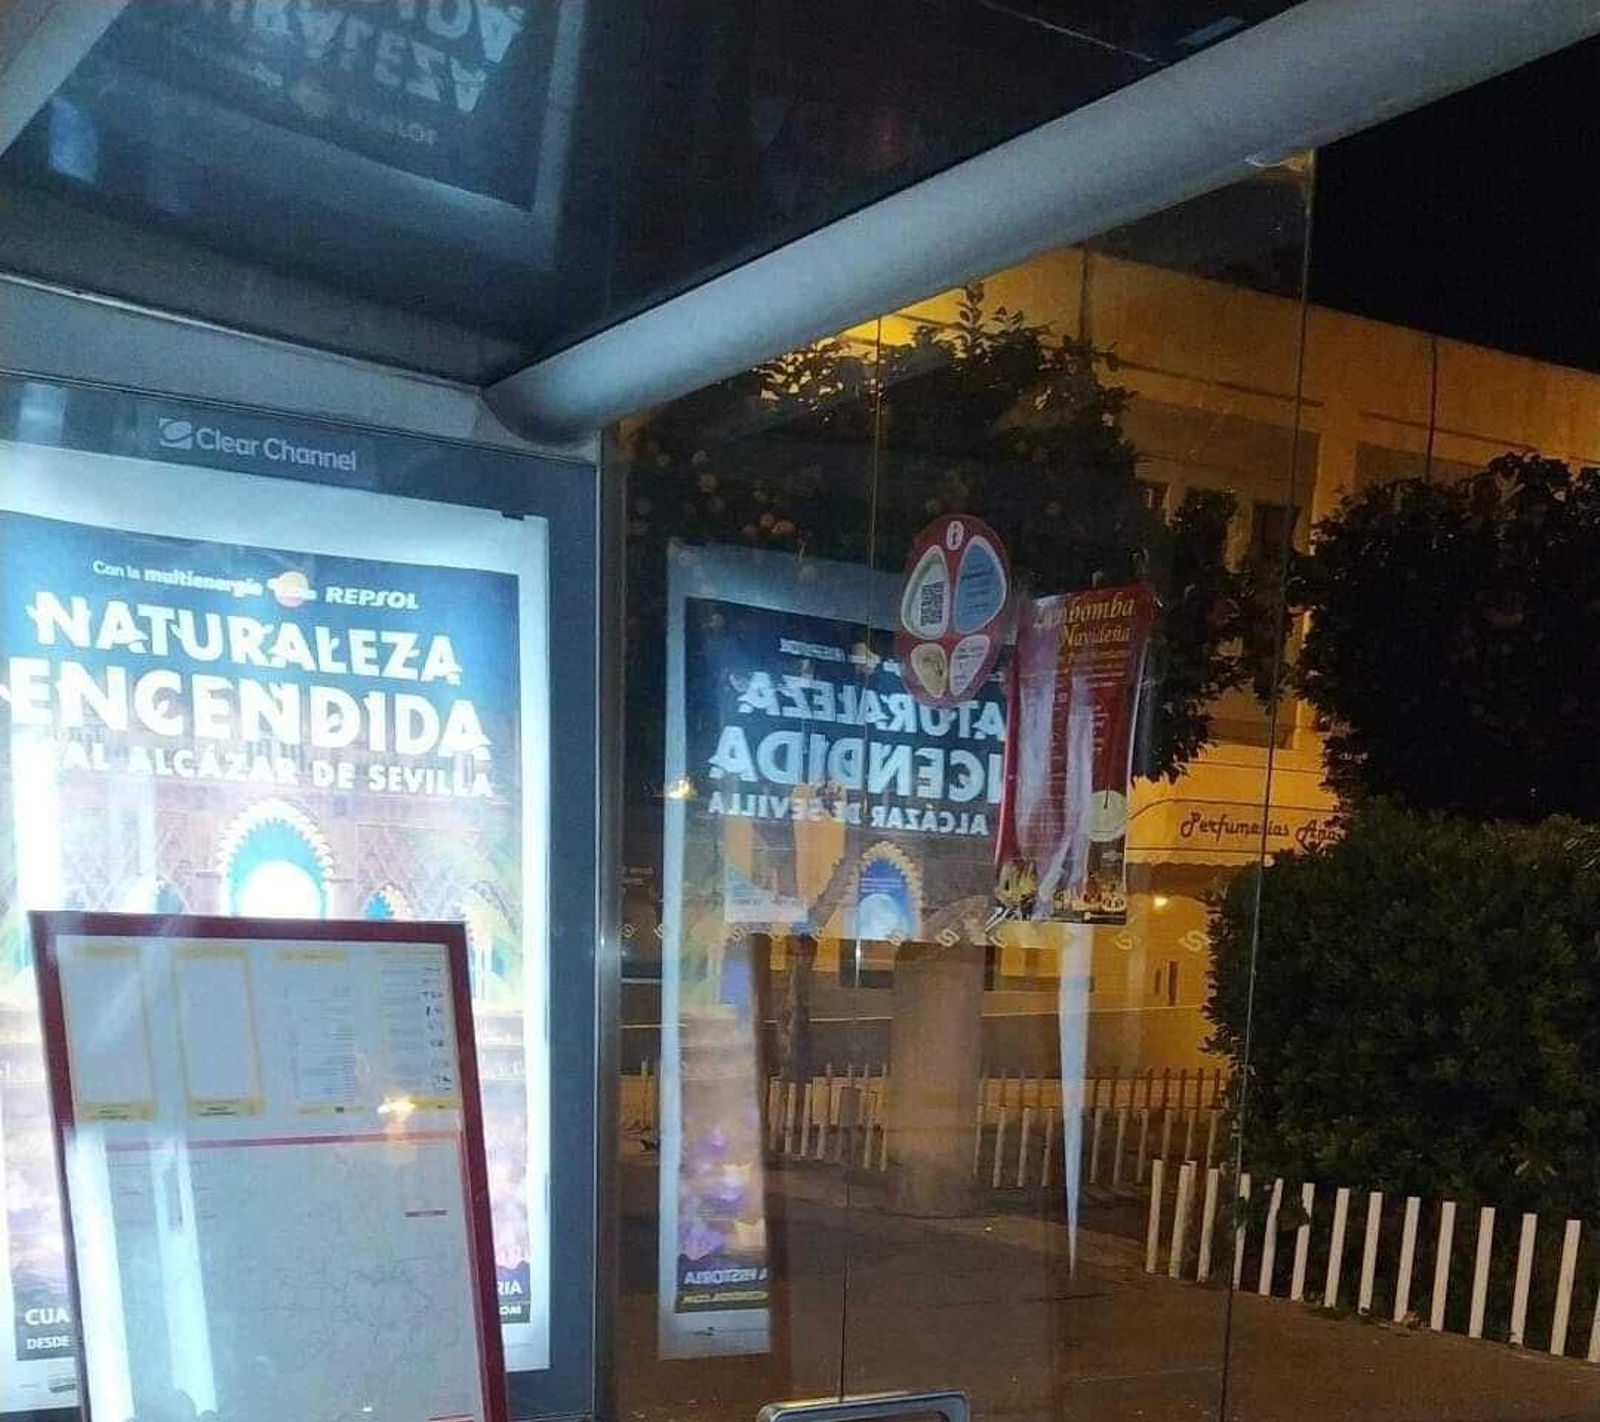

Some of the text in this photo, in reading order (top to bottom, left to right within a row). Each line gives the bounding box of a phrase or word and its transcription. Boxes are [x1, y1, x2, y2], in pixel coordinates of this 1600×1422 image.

[196, 426, 358, 472] Clear Channel
[92, 559, 124, 578] Con
[125, 564, 141, 580] la
[324, 585, 419, 611] REPSOL
[27, 590, 463, 686] NATURALEZA
[7, 656, 493, 761] ENCENDIDA
[312, 759, 356, 790] DE
[368, 763, 494, 798] SEVILLA
